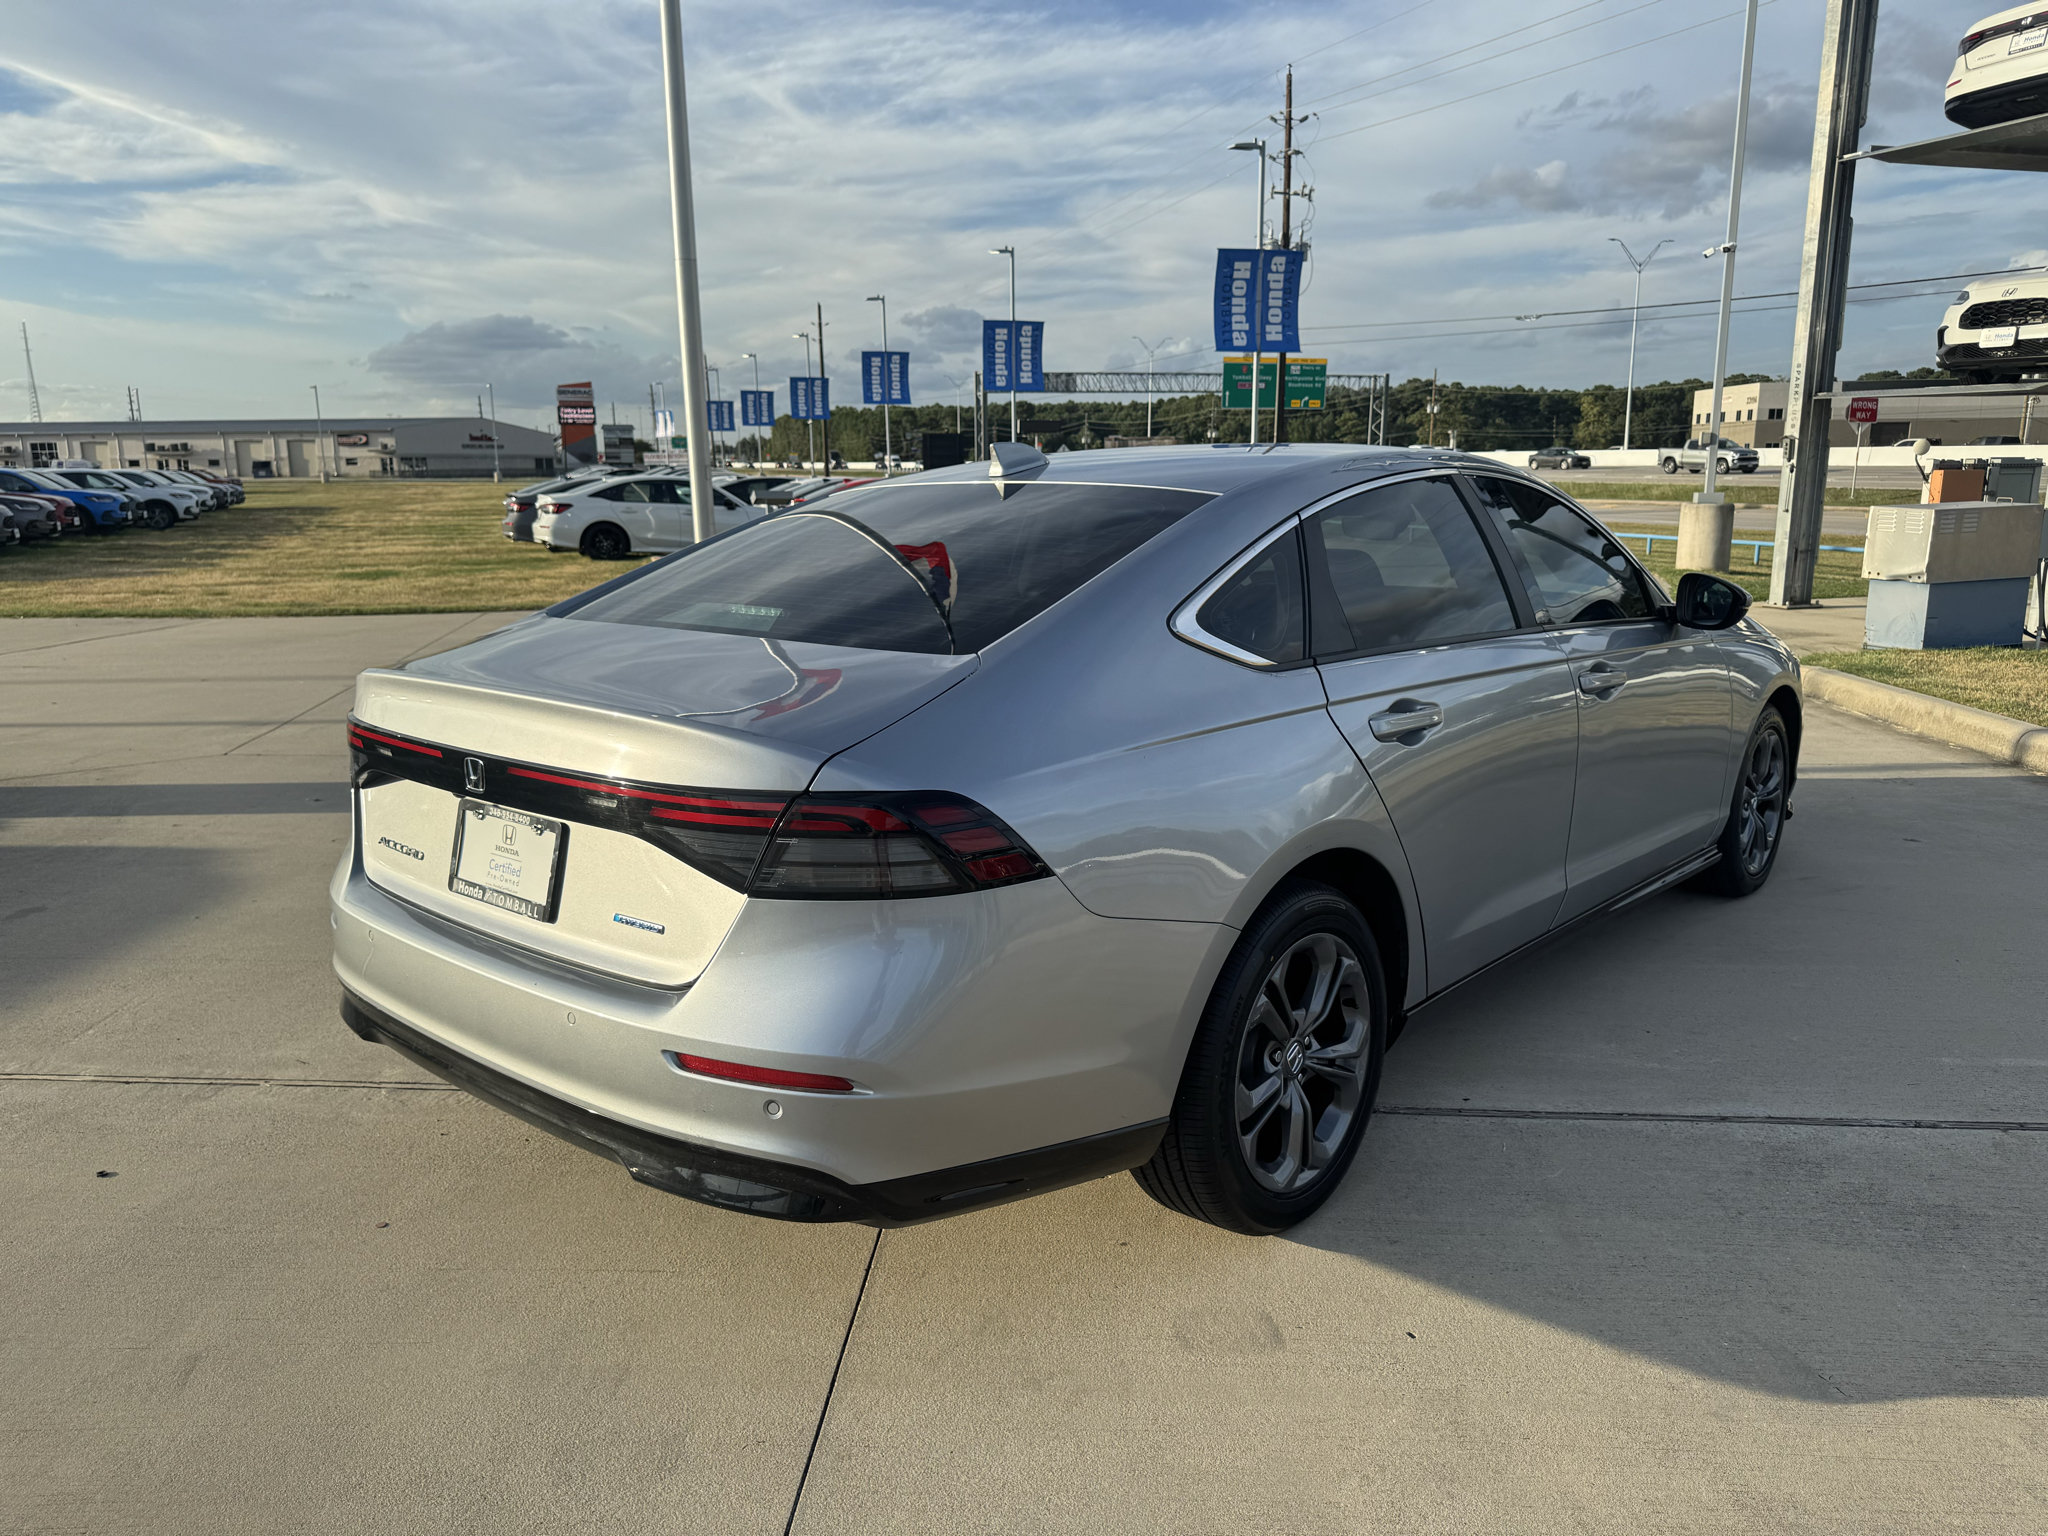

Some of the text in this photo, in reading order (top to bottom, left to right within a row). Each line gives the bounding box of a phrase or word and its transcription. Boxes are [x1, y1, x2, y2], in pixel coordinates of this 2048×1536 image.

[1231, 261, 1252, 347] Honda
[1265, 256, 1287, 341] Honda
[995, 328, 1008, 387] Honda
[1019, 325, 1033, 384] Honda
[871, 357, 882, 401] Honda
[890, 355, 901, 399] Honda
[1853, 401, 1877, 410] WRONG
[1856, 411, 1871, 419] WAY
[378, 836, 425, 861] ACCORD
[495, 844, 520, 857] HONDA
[487, 870, 520, 887] Pre-Owned
[489, 858, 522, 878] Certified
[458, 881, 483, 899] Honda
[492, 892, 539, 918] TOMBALL
